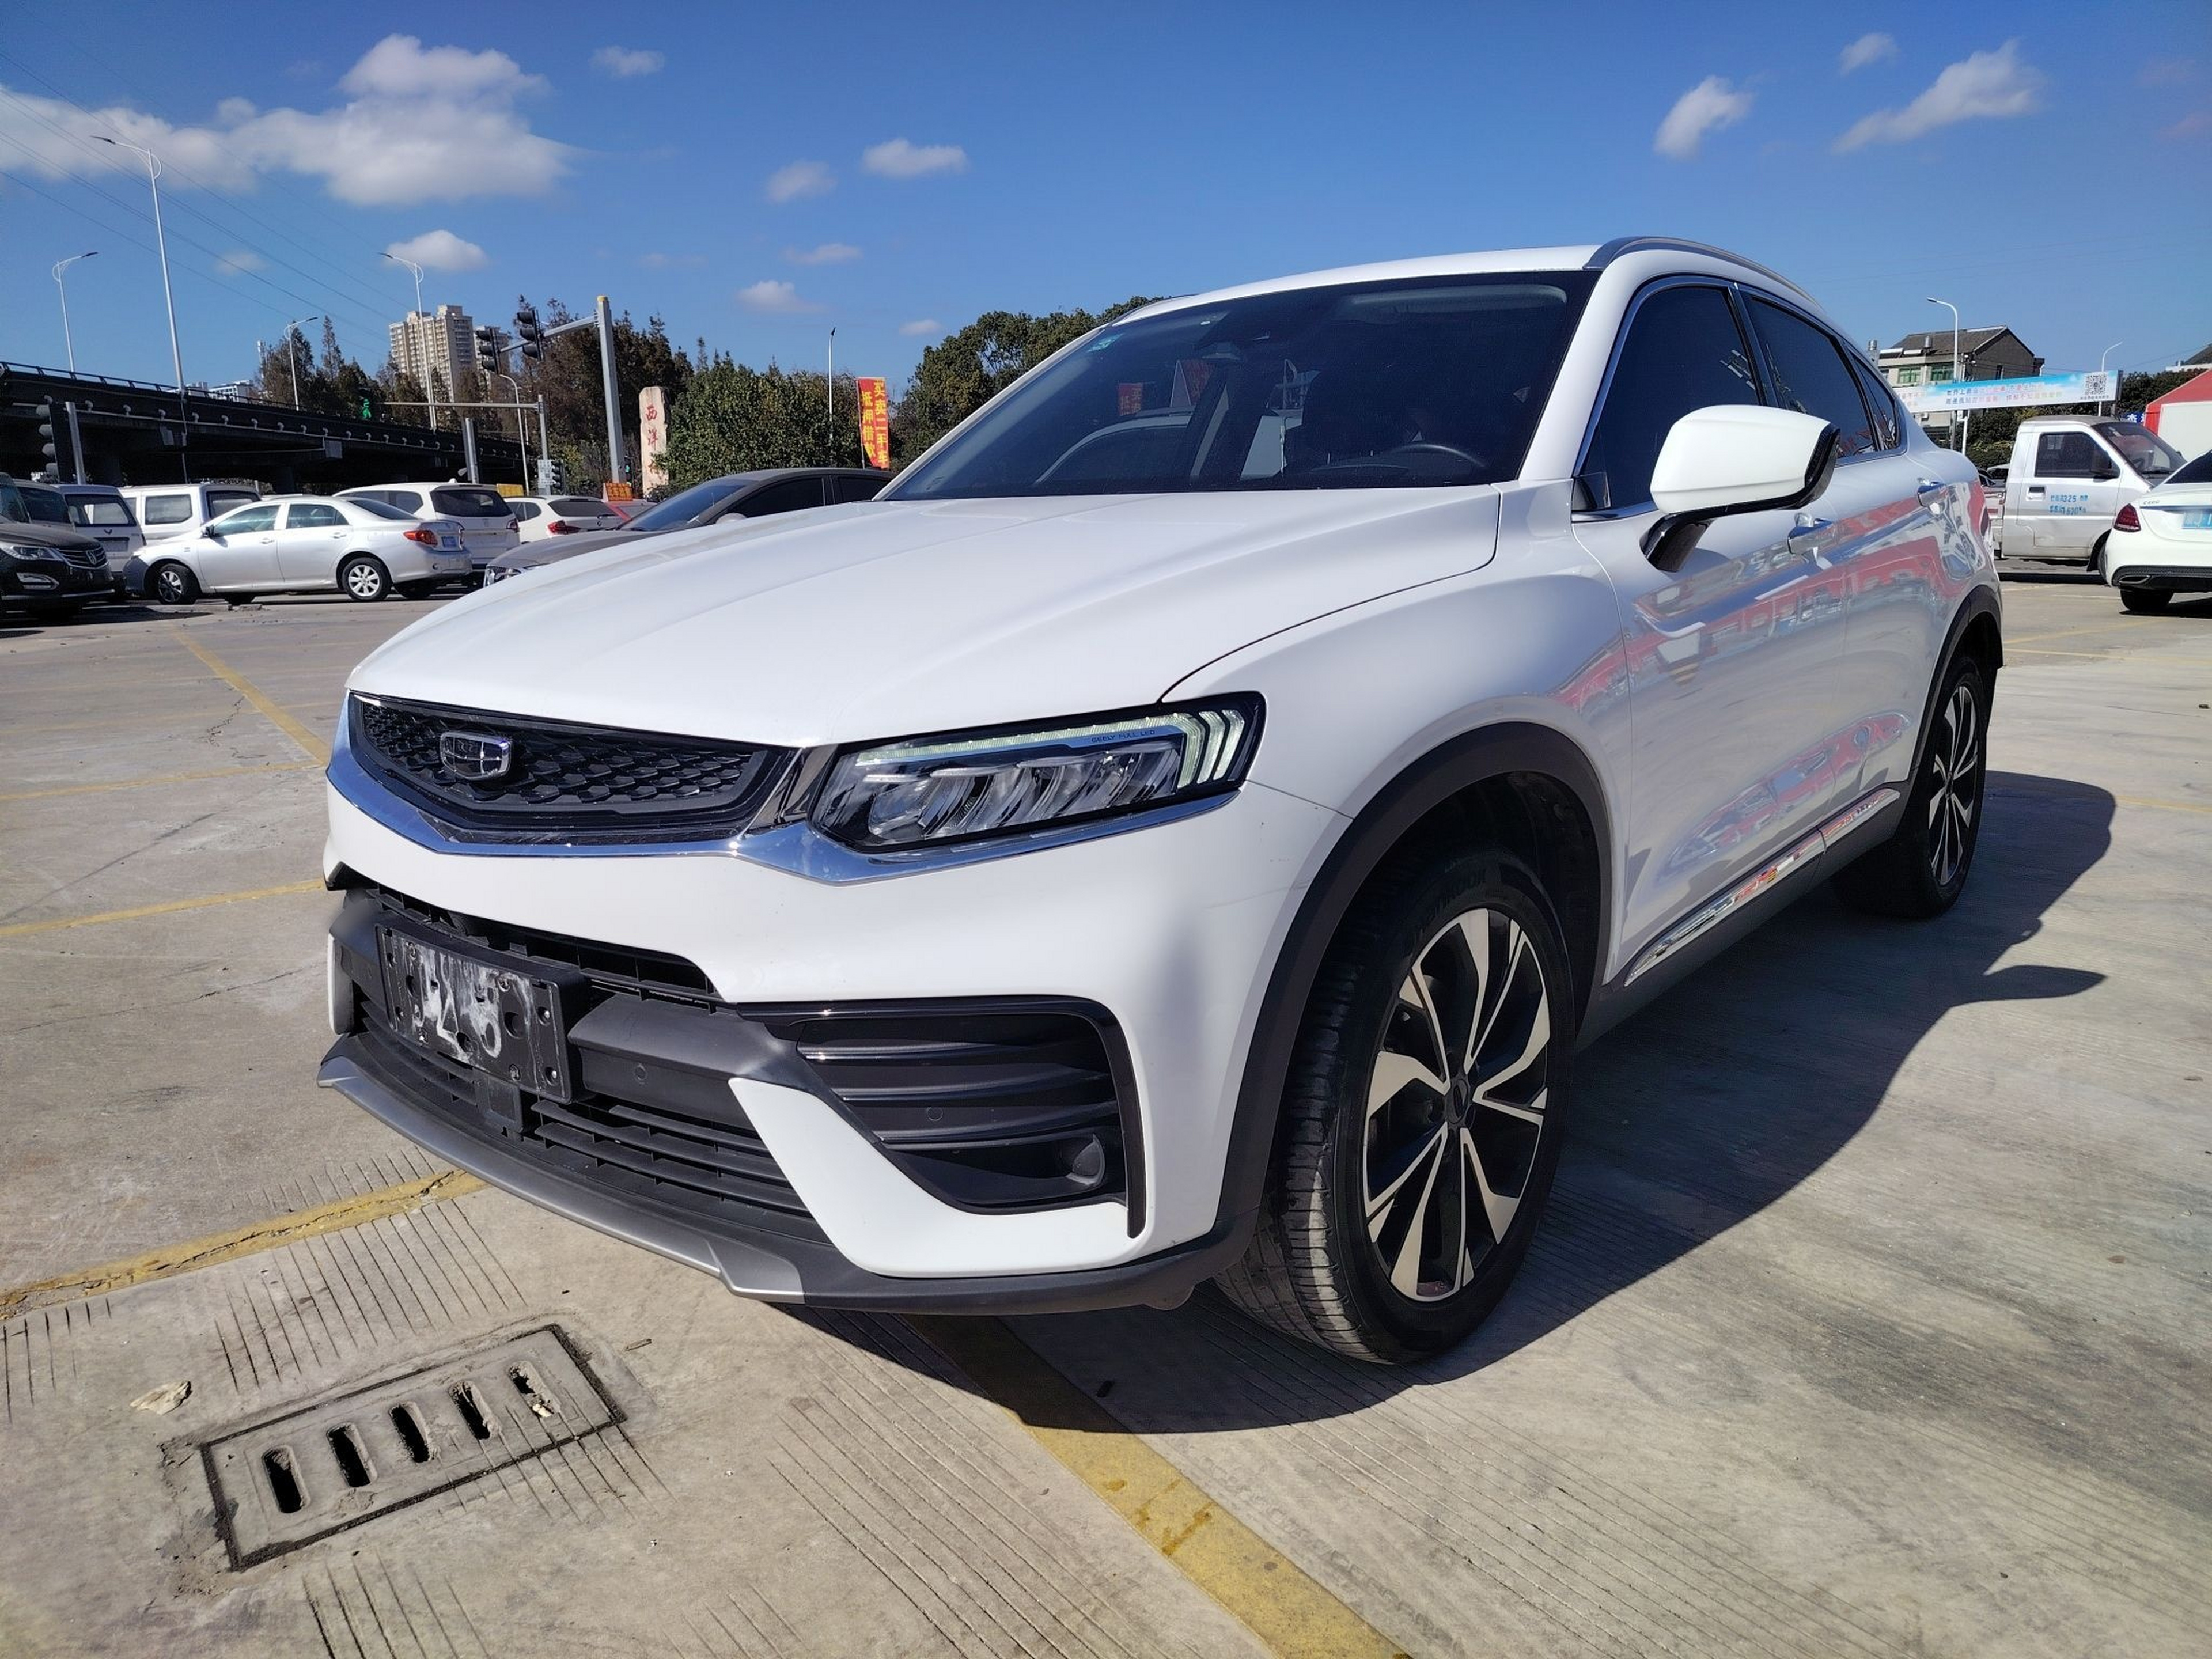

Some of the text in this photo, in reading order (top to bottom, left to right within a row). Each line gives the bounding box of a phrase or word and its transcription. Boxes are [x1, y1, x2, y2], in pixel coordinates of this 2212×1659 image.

[862, 391, 876, 457] 抵押借款
[874, 380, 888, 464] 买卖二手车
[1092, 734, 1116, 743] GEELY
